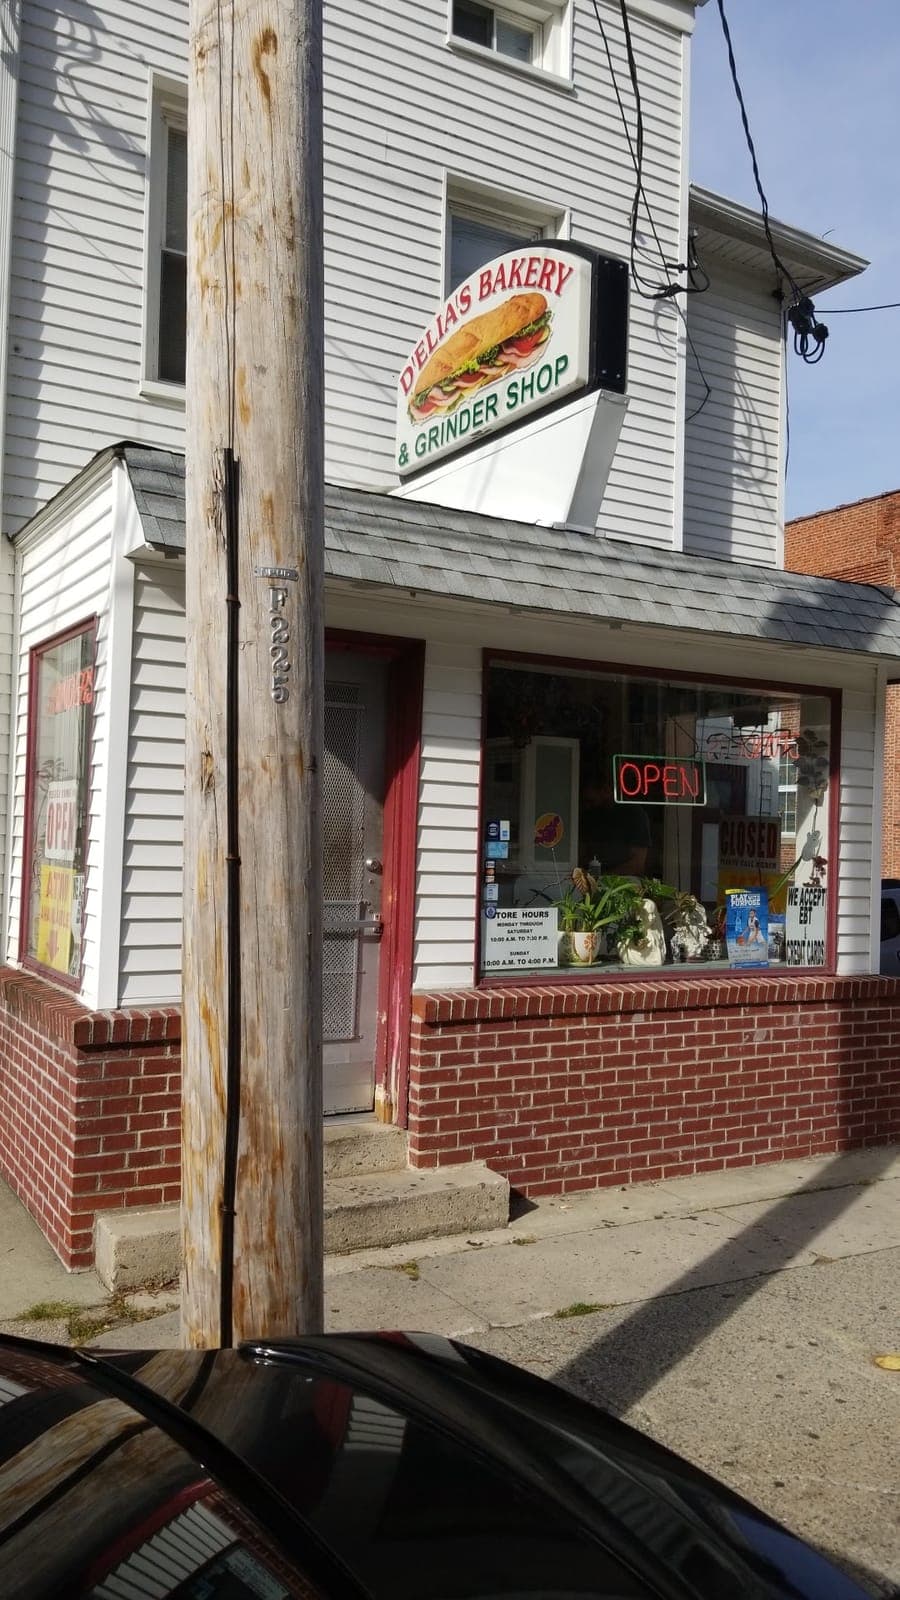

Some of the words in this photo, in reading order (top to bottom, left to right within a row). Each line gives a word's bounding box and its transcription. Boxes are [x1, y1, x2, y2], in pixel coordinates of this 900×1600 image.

[399, 285, 472, 396] D'ELIA'S
[479, 256, 573, 301] BAKERY
[398, 443, 409, 466] &
[414, 393, 498, 456] GRINDER
[506, 354, 569, 409] SHOP
[619, 762, 699, 797] OPEN
[47, 801, 74, 850] OPEN
[720, 821, 777, 858] CLOSED
[522, 911, 549, 919] HOURS
[788, 888, 798, 906] WE
[799, 888, 826, 906] ACCEPT
[799, 906, 813, 924] EBT
